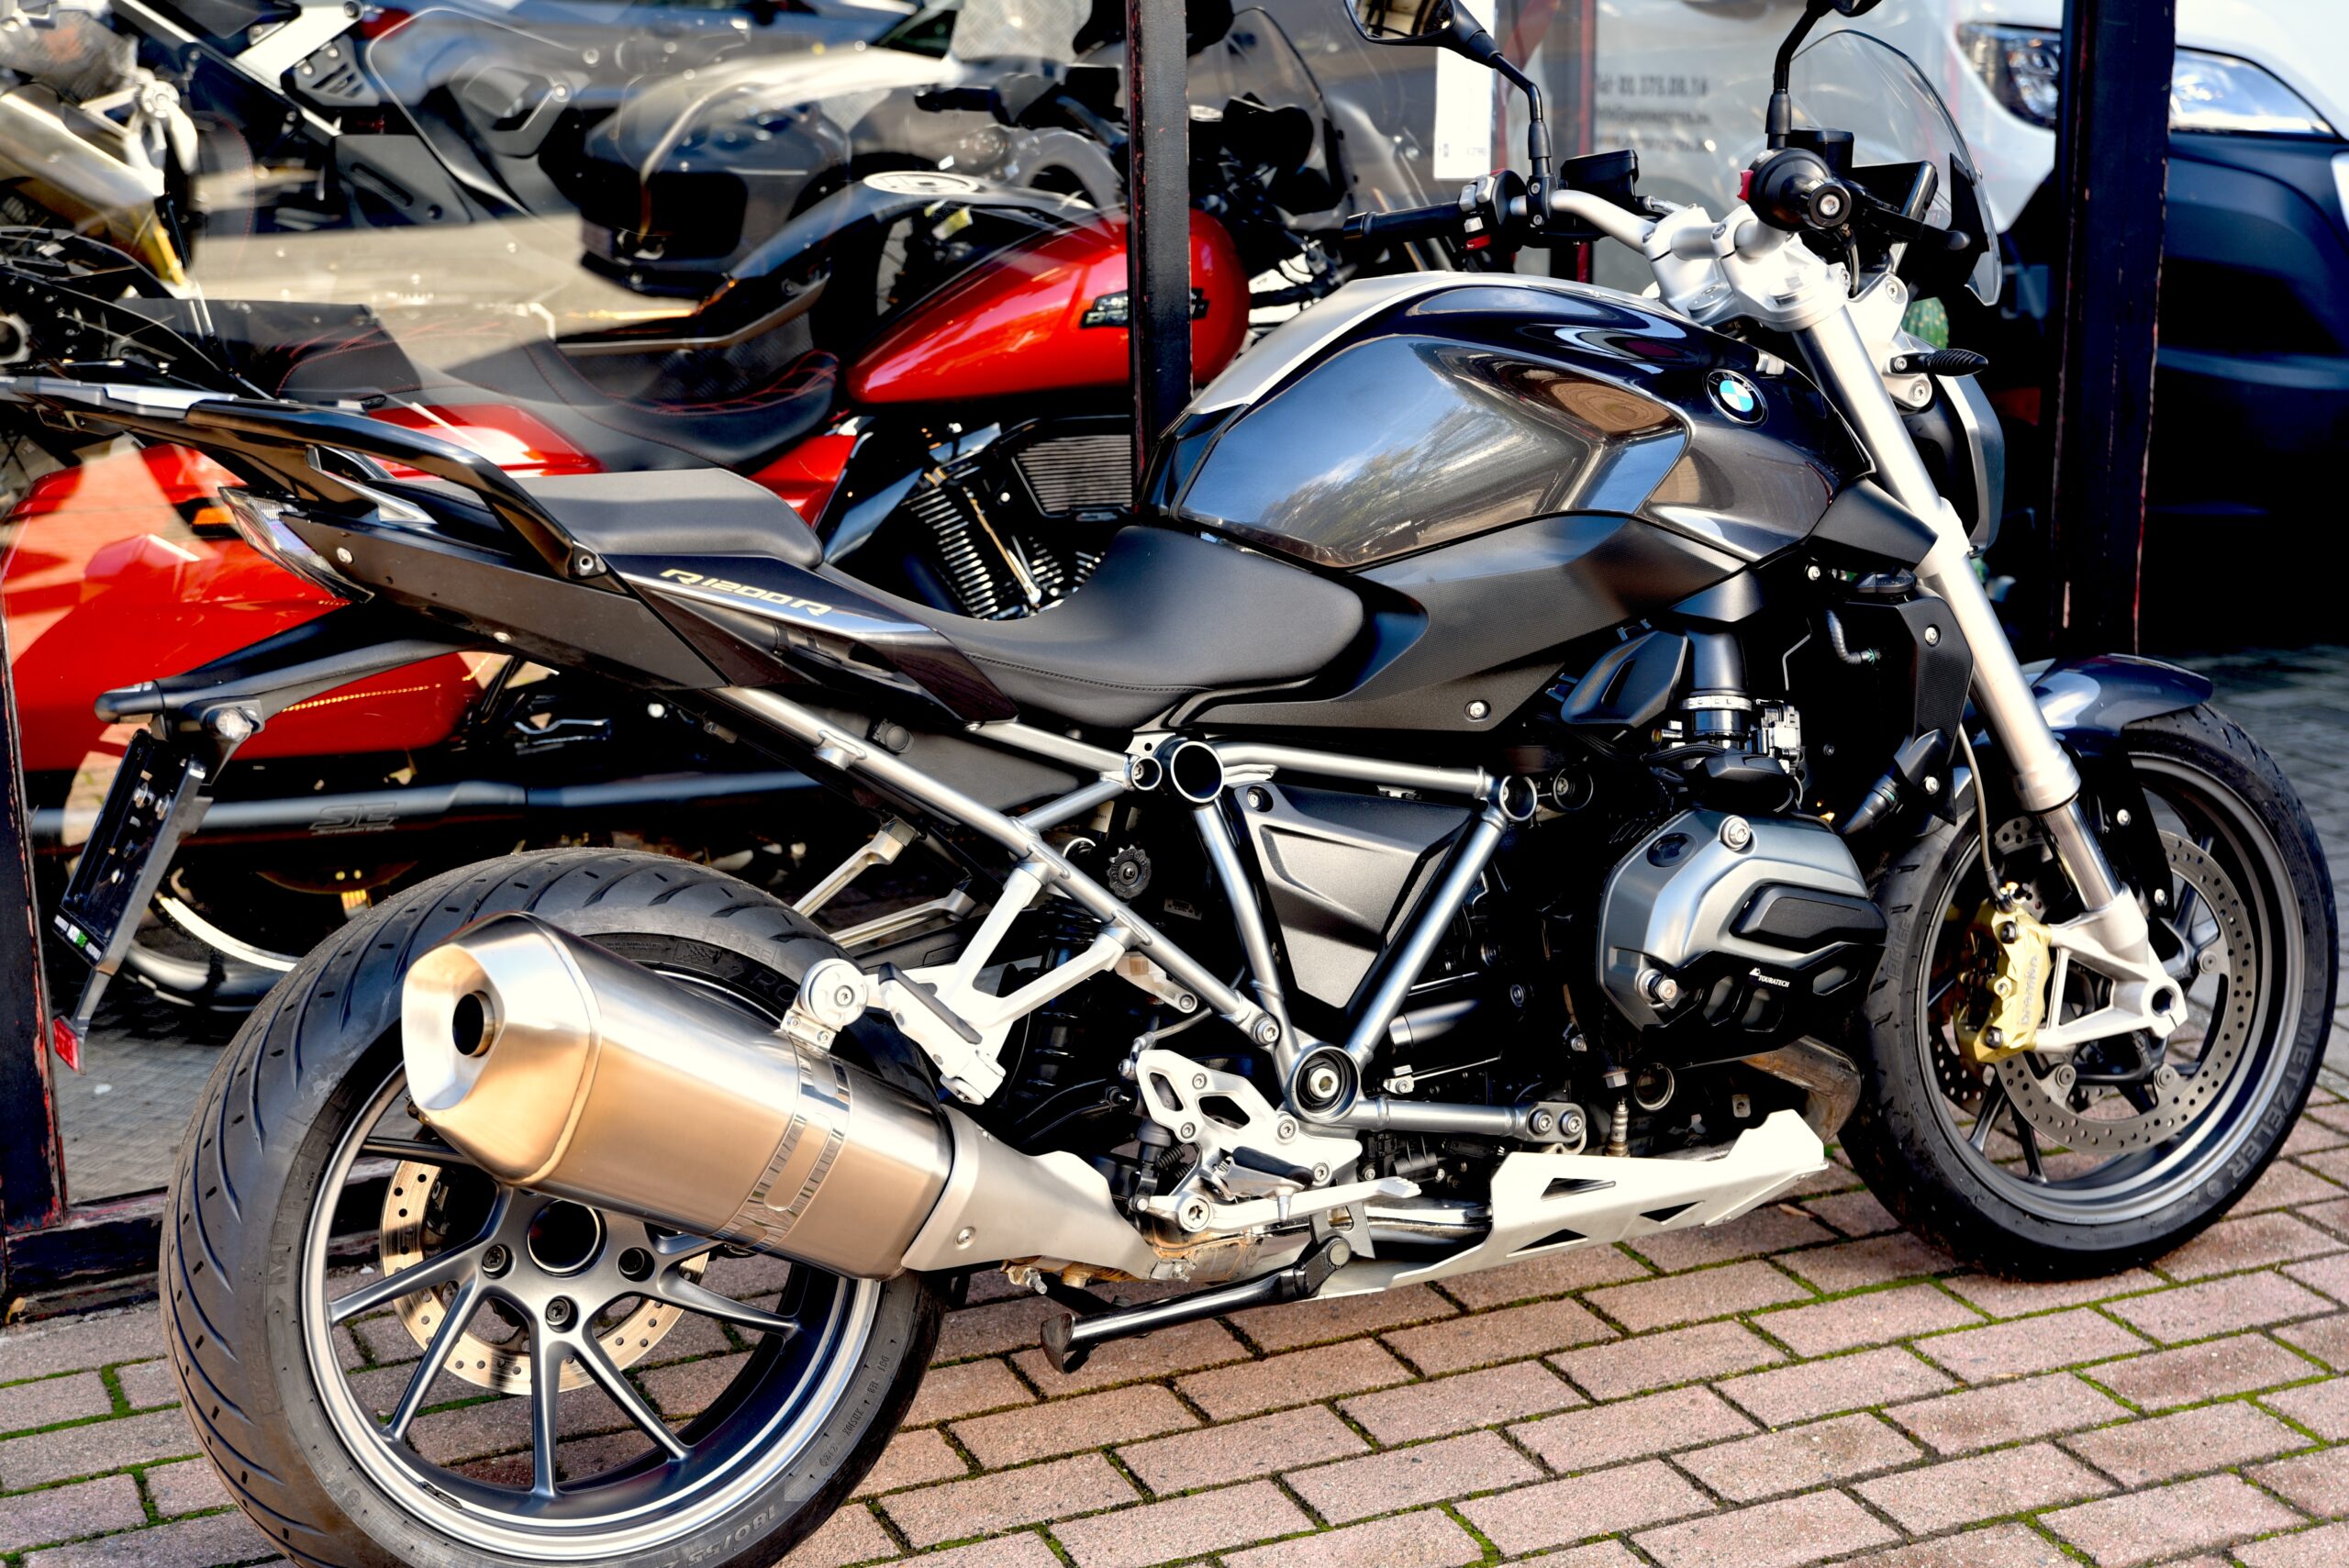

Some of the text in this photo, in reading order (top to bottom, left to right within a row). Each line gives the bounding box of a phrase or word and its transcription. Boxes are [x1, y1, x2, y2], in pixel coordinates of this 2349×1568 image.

[1758, 974, 1790, 988] TOURATECH
[2018, 955, 2038, 1025] brembo
[2225, 1017, 2321, 1179] METZELER
[688, 1504, 776, 1566] 180/55
